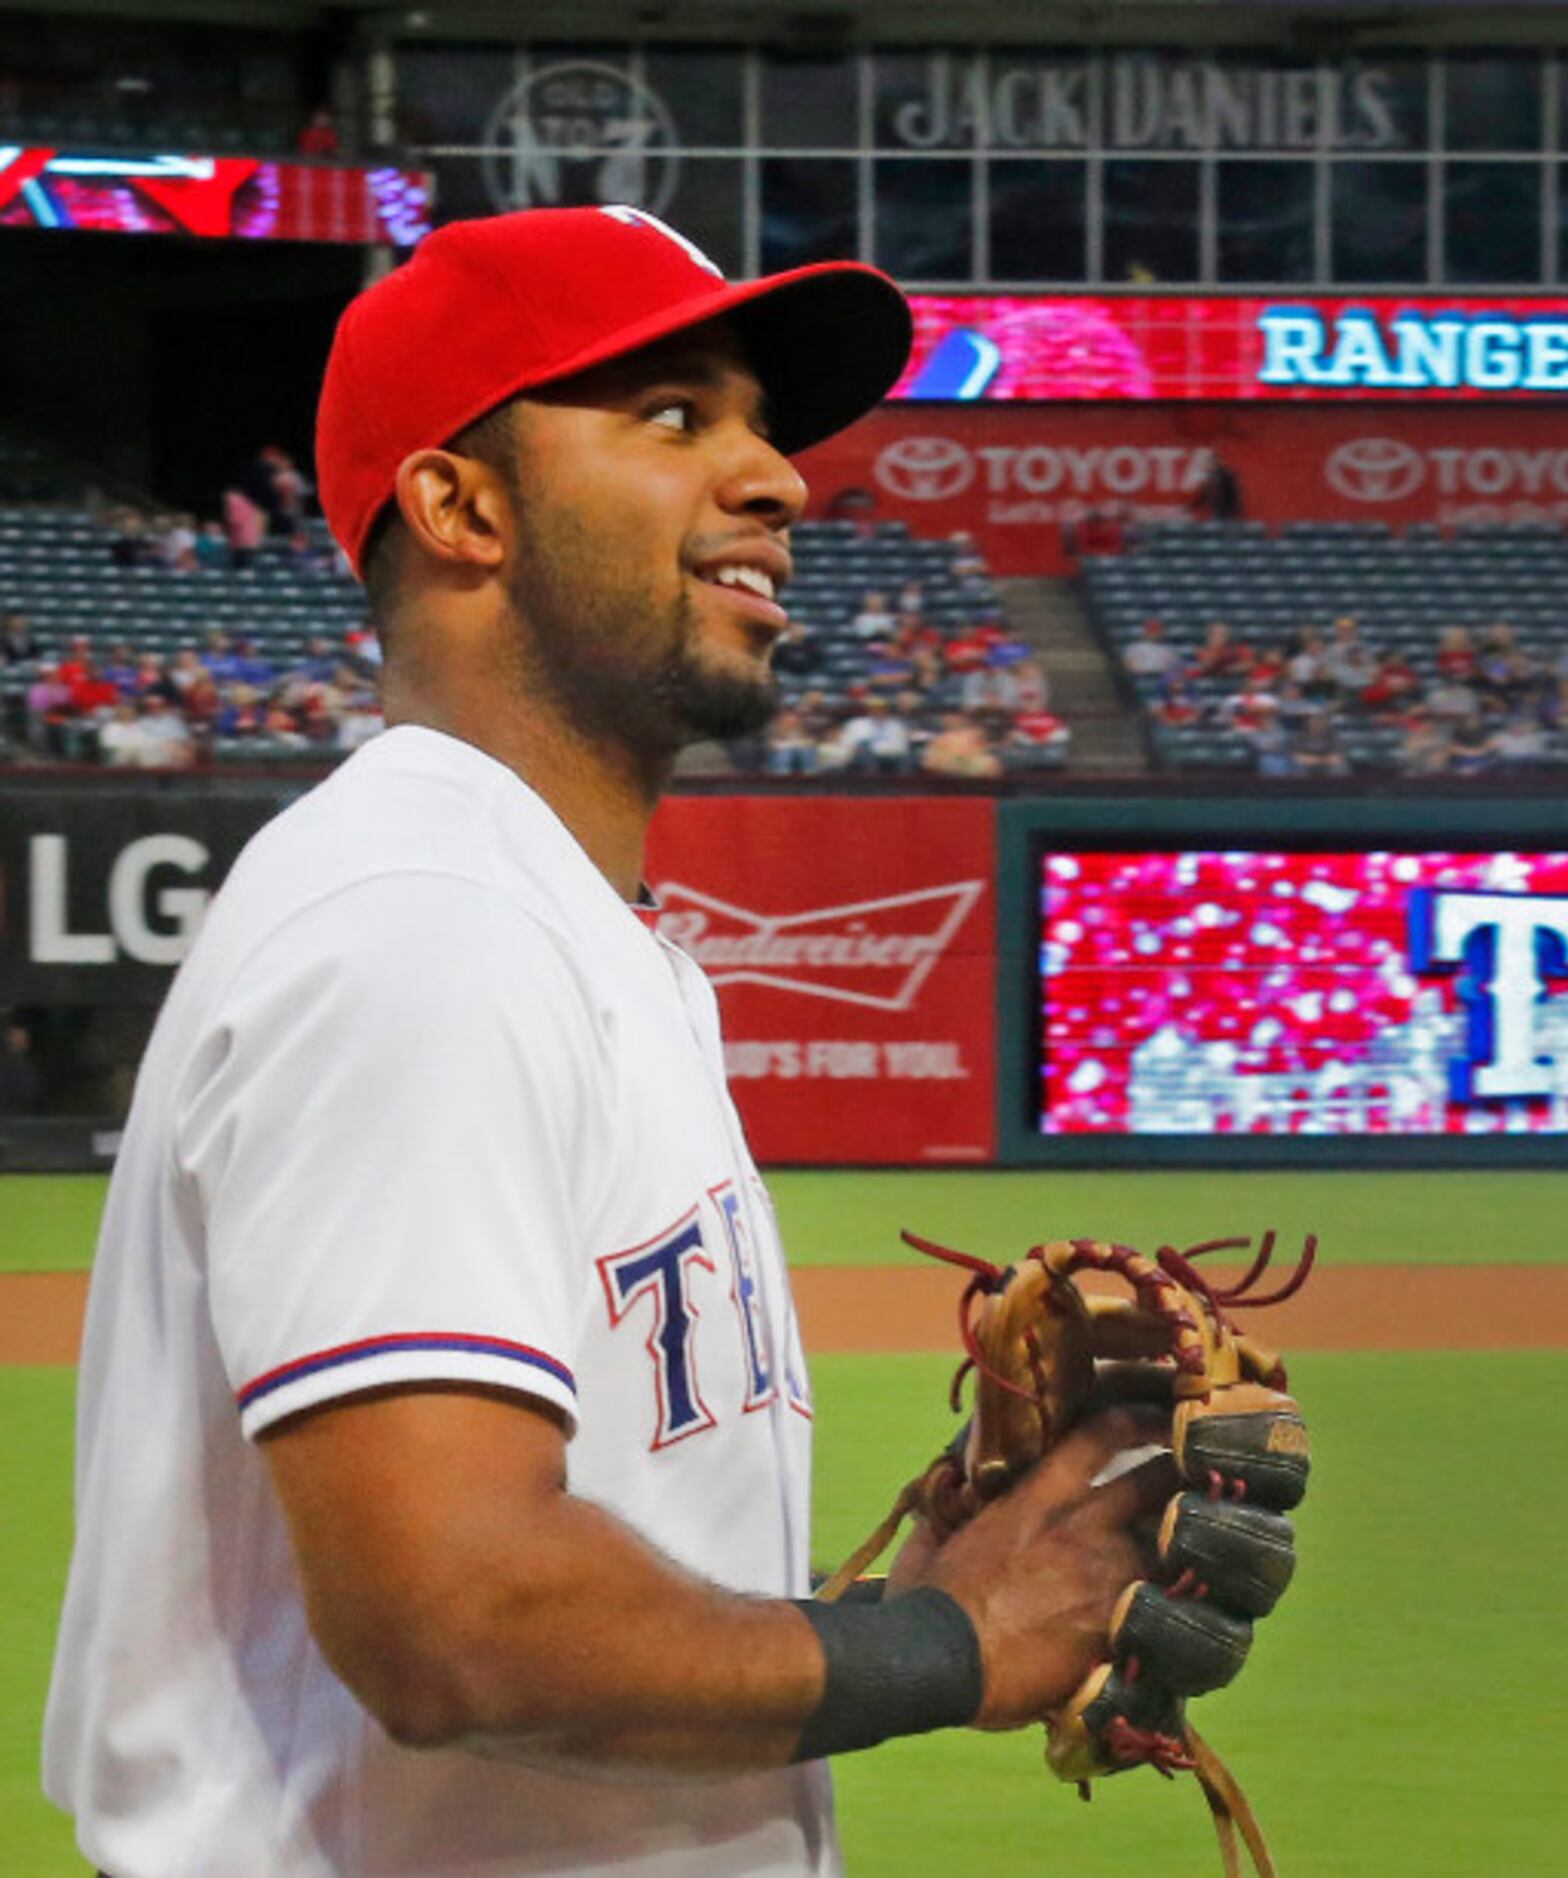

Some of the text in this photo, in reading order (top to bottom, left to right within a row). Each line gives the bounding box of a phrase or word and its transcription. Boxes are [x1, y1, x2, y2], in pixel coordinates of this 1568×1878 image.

[894, 54, 1087, 147] JACK
[978, 446, 1215, 493] TOYOTA
[29, 833, 211, 965] LG
[655, 911, 938, 967] Budweiser
[806, 1041, 878, 1078] FOR
